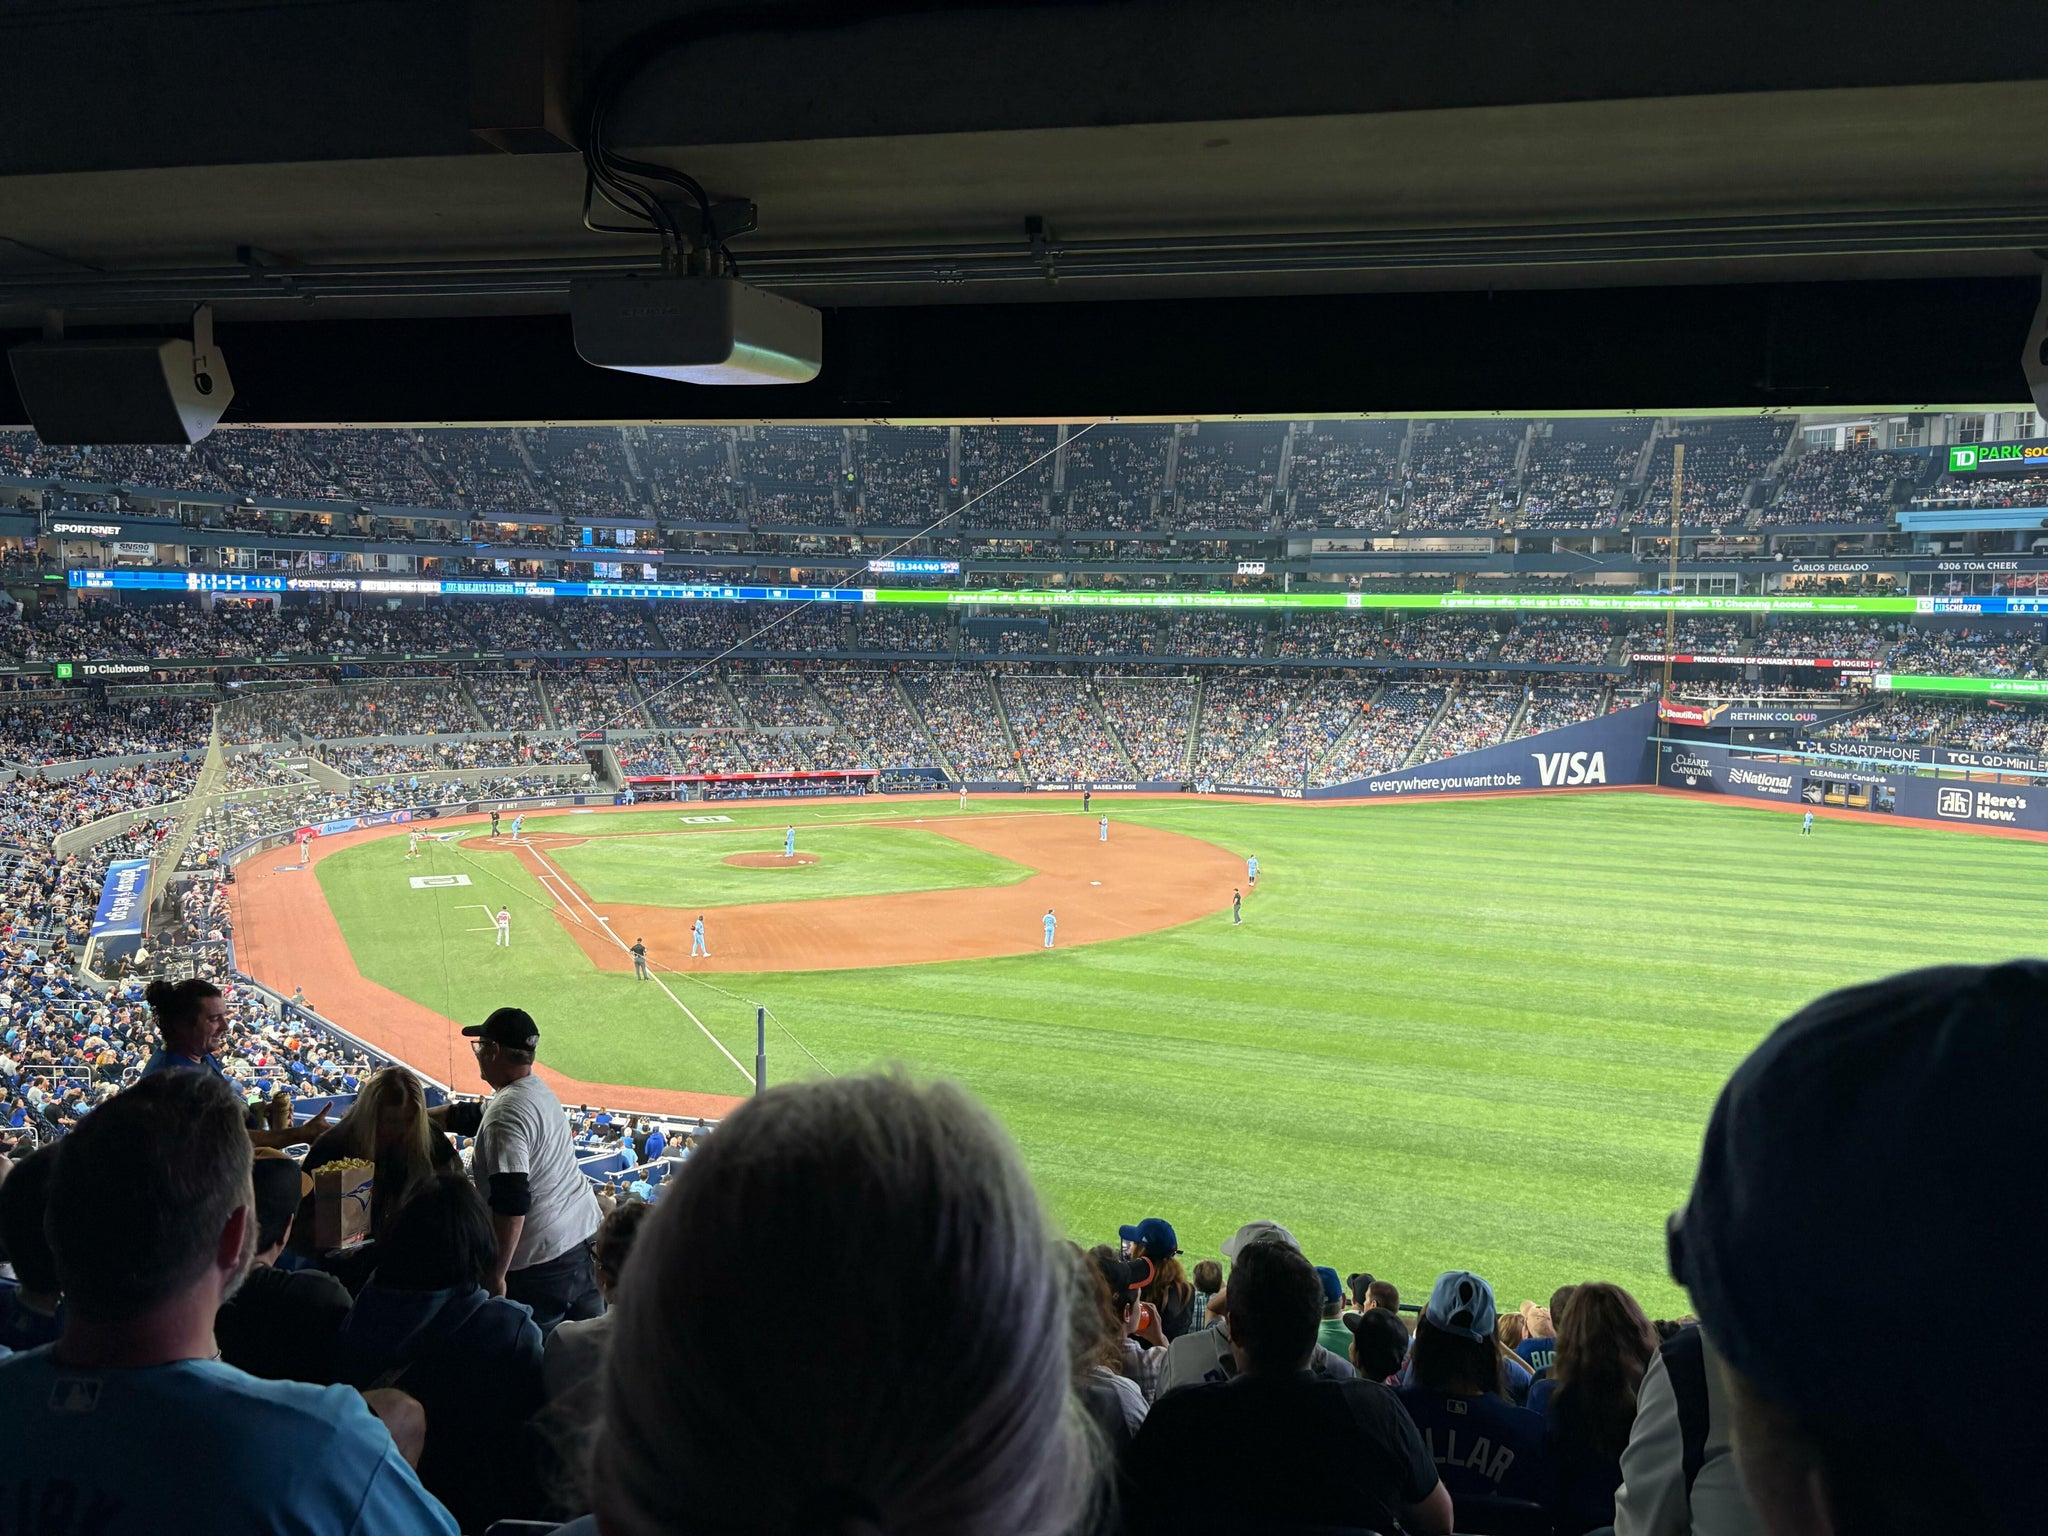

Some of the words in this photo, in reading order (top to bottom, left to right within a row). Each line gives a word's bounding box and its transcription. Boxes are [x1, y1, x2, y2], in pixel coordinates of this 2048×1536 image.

[1953, 451, 1975, 466] TD
[1979, 445, 2023, 460] PARK
[53, 524, 121, 534] SPORTSNET
[1828, 564, 1869, 572] DELGADO
[1938, 562, 1960, 570] 4306
[1964, 562, 1984, 570] TOM
[1987, 562, 2018, 570] CHEEK
[298, 579, 330, 588] DISTRICT
[1448, 598, 1474, 608] grand
[1536, 600, 1548, 608] up
[1612, 599, 1623, 608] by
[1624, 600, 1660, 609] opening
[1675, 600, 1708, 610] eligible
[1725, 600, 1770, 610] Chequing
[1772, 600, 1816, 608] Account.
[1944, 604, 1982, 612] SCHERZER
[82, 666, 98, 674] TD
[98, 664, 150, 674] Clubhouse
[1990, 682, 2012, 690] Let's
[2012, 682, 2039, 690] knock
[1666, 710, 1702, 720] BeautiTone
[1730, 712, 1774, 721] RETHINK
[1775, 713, 1818, 722] COLOUR
[1797, 741, 1825, 752] TCL
[1830, 743, 1920, 761] SMARTPHONE
[1676, 754, 1709, 767] CLEARLY
[1948, 752, 1979, 765] TCL
[1532, 752, 1606, 786] VISA
[1670, 763, 1712, 777] CANADIAN
[1370, 776, 1440, 793] everywhere
[1440, 777, 1462, 790] you
[1464, 775, 1492, 787] want
[1493, 775, 1504, 786] to
[1506, 772, 1521, 786] be
[1852, 774, 1880, 782] Canada
[1194, 783, 1216, 792] VA
[1280, 789, 1302, 798] VISA
[1977, 792, 2027, 810] Here's
[1976, 806, 2016, 822] How.
